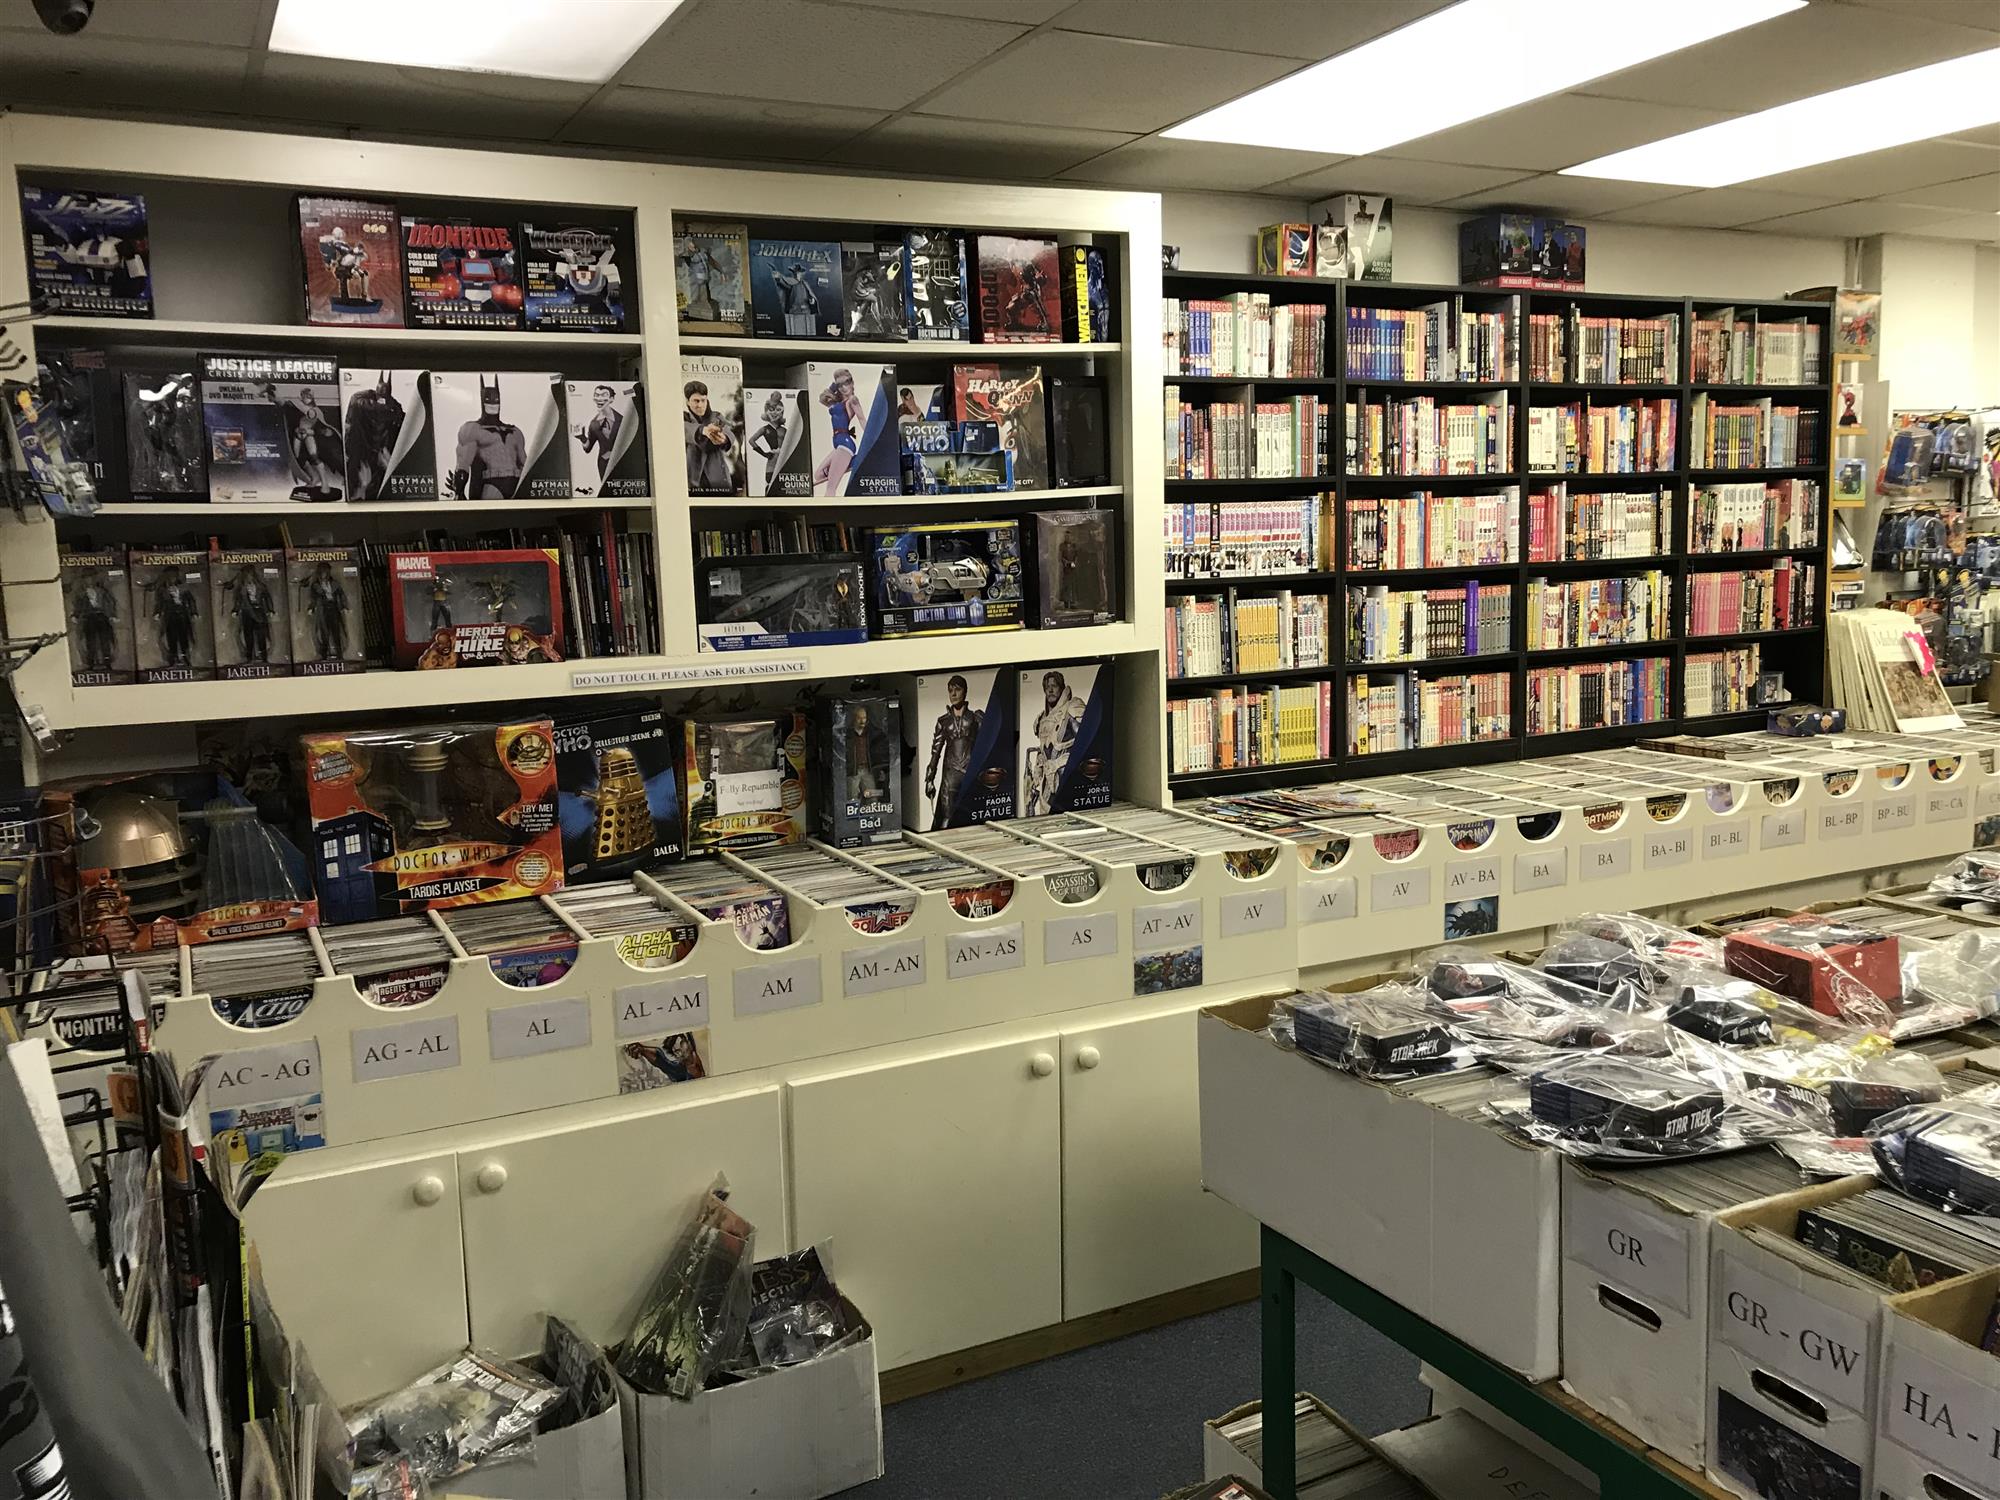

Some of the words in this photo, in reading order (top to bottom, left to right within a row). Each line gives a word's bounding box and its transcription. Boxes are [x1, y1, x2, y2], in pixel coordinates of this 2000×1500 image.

[207, 358, 271, 372] JUSTICE
[276, 360, 332, 374] LEAGUE
[208, 370, 243, 378] CRISIS
[294, 373, 332, 381] EARTHS
[905, 425, 947, 435] DOCTOR
[906, 435, 949, 452] WHO
[859, 479, 899, 487] STARGIRL
[613, 488, 646, 496] STATUE
[143, 554, 197, 565] LABYRINTH
[221, 553, 273, 564] LABYRINTH
[298, 551, 348, 562] LABYRINTH
[396, 557, 432, 570] MARVEL
[913, 608, 945, 622] DOCTOR
[947, 606, 967, 619] WHO
[456, 626, 506, 637] HEROES
[454, 639, 505, 652] HIRE
[227, 666, 271, 678] JARETH
[303, 662, 345, 674] JARETH
[575, 676, 591, 686] DO
[593, 674, 616, 684] NOT
[661, 669, 700, 680] PLEASE
[702, 667, 723, 677] ASK
[725, 666, 746, 676] FOR
[748, 662, 806, 674] ASSISTANCE
[148, 669, 194, 682] JARETH
[720, 784, 739, 795] Flly
[522, 804, 536, 812] TRY
[538, 804, 553, 812] ME!
[986, 796, 1012, 806] FAORA
[1074, 795, 1110, 807] STATUE
[1950, 798, 1963, 809] CA
[847, 802, 894, 815] Breaking
[971, 806, 1012, 820] STATUE
[1878, 808, 1890, 820] BP
[720, 817, 751, 829] DOCTOR
[860, 817, 881, 829] Bad
[1583, 809, 1622, 825] BATMAN
[1825, 816, 1837, 827] BL
[1846, 813, 1858, 825] BP
[1777, 823, 1791, 836] BL
[1710, 834, 1721, 847] BI
[1729, 832, 1743, 844] BL
[653, 844, 680, 857] DALEK
[1651, 845, 1667, 857] BA
[1675, 840, 1685, 853] BI
[394, 851, 448, 871] DOCTOR
[460, 846, 491, 862] WHO
[1598, 853, 1614, 866] BA
[1450, 872, 1468, 887] AV
[1478, 869, 1496, 883] BA
[1533, 864, 1549, 878] BA
[409, 886, 441, 899] TARDIS
[442, 879, 481, 895] PLAYSET
[1057, 885, 1088, 896] CREED
[1392, 882, 1410, 896] AV
[1317, 893, 1337, 907] AV
[1243, 904, 1263, 920] AV
[1142, 918, 1162, 934] AT
[1173, 913, 1194, 930] AV
[617, 931, 673, 953] ALPHA
[1072, 929, 1092, 945] AS
[622, 942, 679, 960] FLIGHT
[955, 944, 980, 963] AN
[995, 939, 1016, 956] AS
[74, 959, 85, 970] A
[849, 962, 878, 981] AM
[893, 954, 919, 973] AN
[380, 984, 407, 996] AGENTS
[419, 977, 440, 989] ATLAS
[762, 977, 793, 997] AM
[623, 1001, 652, 1021] AL
[668, 992, 702, 1012] AM
[59, 1015, 116, 1040] MONTH
[526, 1017, 556, 1037] AL
[363, 1042, 398, 1065] AG
[417, 1035, 450, 1056] AL
[1390, 1044, 1415, 1063] STAR
[1415, 1038, 1439, 1057] TREK
[218, 1066, 253, 1089] AC
[274, 1058, 311, 1081] AG
[1665, 1115, 1689, 1139] STAR
[1690, 1107, 1712, 1130] TREK
[1608, 1228, 1646, 1268] GR
[1728, 1291, 1770, 1336] GR
[1800, 1329, 1860, 1377] GW
[1902, 1382, 1957, 1440] HA
